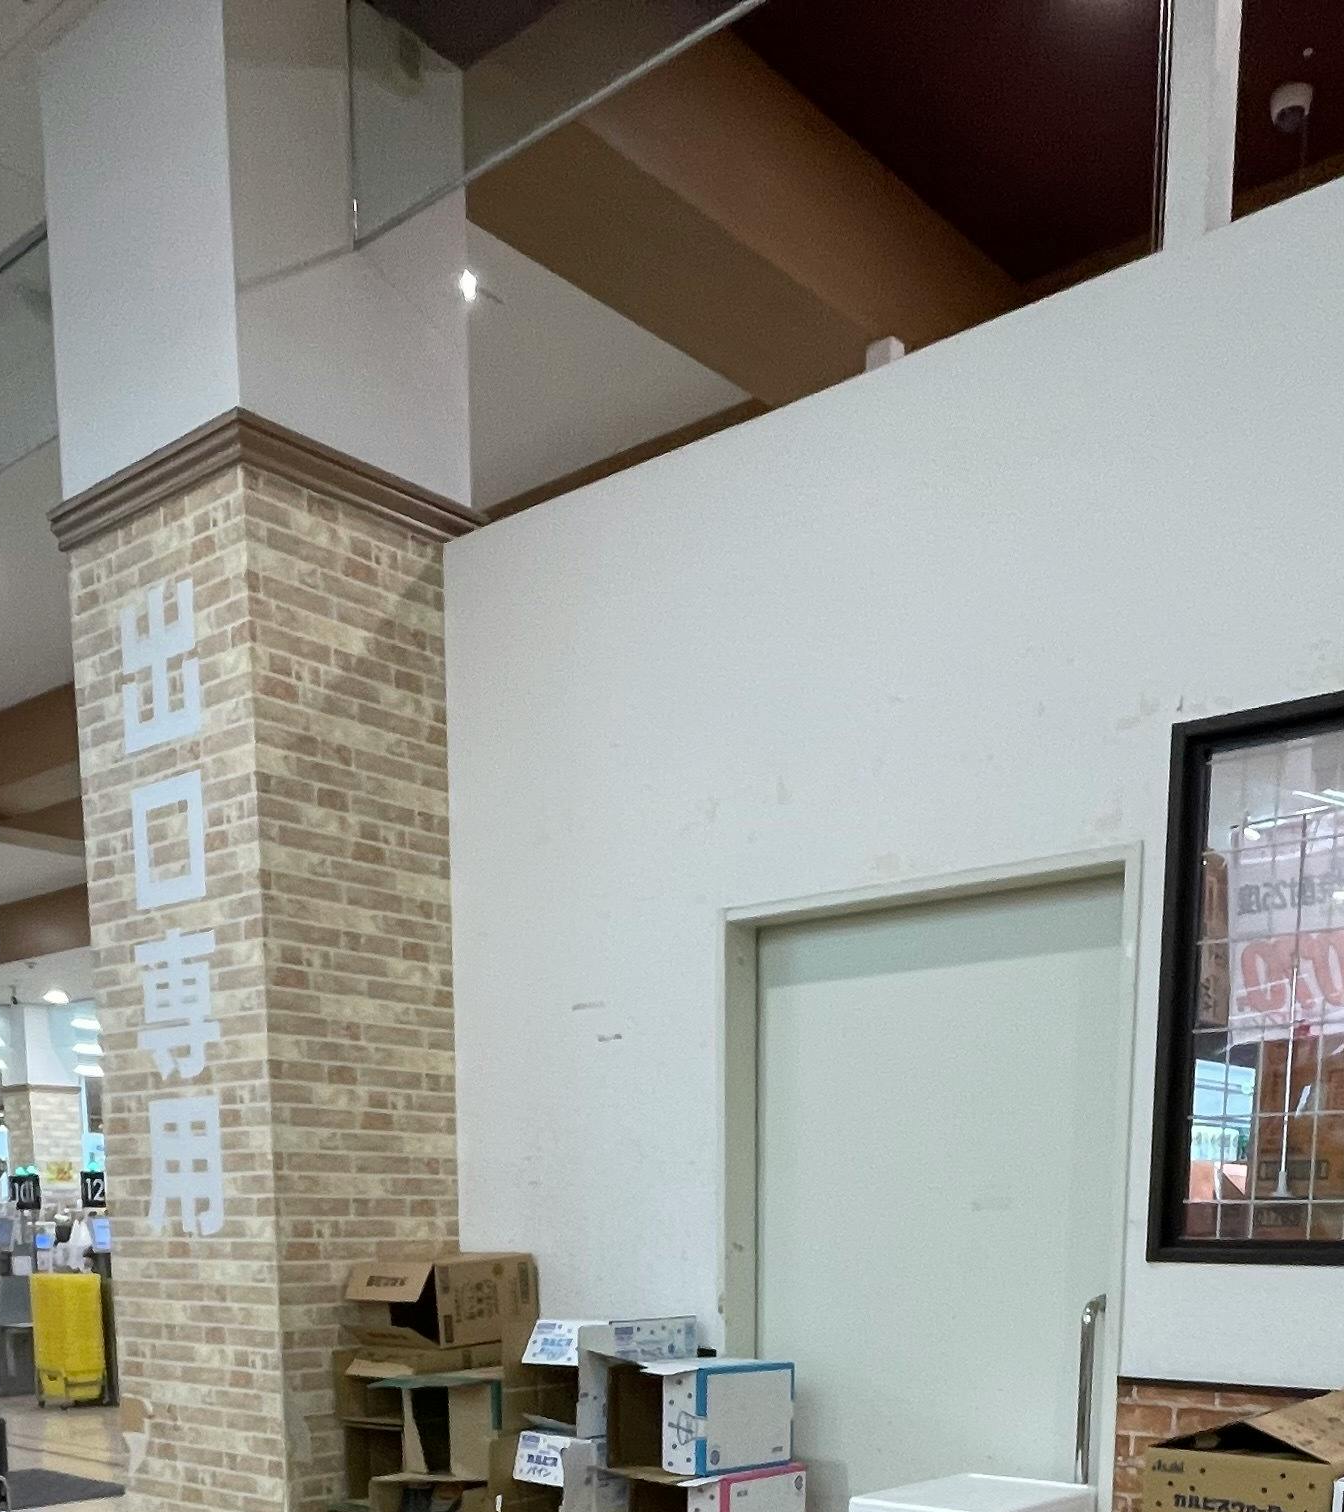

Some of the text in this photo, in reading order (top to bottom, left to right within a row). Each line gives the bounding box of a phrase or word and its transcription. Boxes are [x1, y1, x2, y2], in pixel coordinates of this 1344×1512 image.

[119, 577, 224, 1237] 出口専用
[85, 1177, 106, 1202] 12
